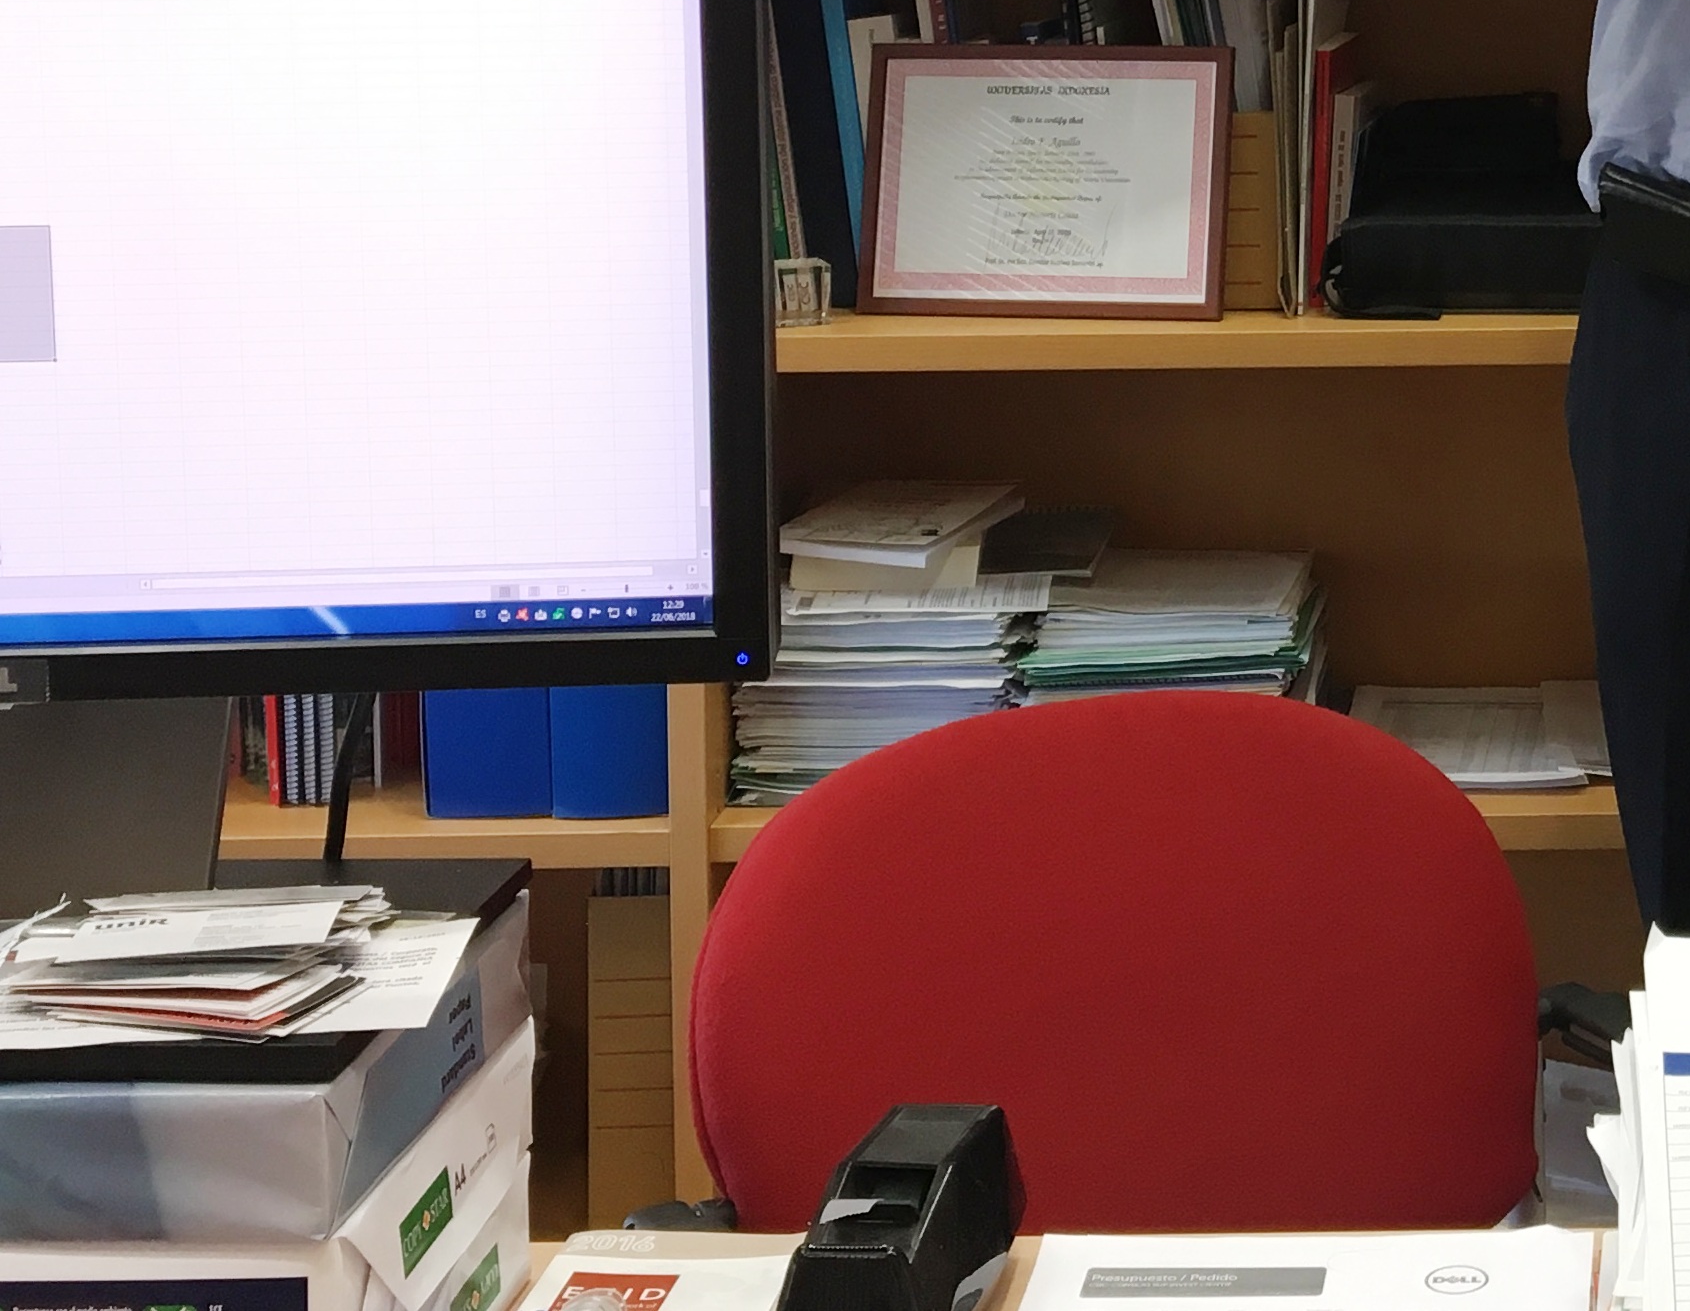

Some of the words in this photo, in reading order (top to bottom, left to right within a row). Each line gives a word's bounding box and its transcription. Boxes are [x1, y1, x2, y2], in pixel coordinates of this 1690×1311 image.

[475, 609, 487, 619] ES
[448, 992, 473, 1025] Paper
[451, 1017, 475, 1053] Label
[440, 1042, 477, 1094] Standard
[454, 1162, 467, 1198] A4
[402, 1222, 424, 1259] COPY
[429, 1186, 450, 1224] STAR
[571, 1234, 657, 1253] 2016
[1091, 1272, 1177, 1283] Presupuesto
[1189, 1272, 1239, 1282] Pedido
[1431, 1275, 1482, 1285] DELL
